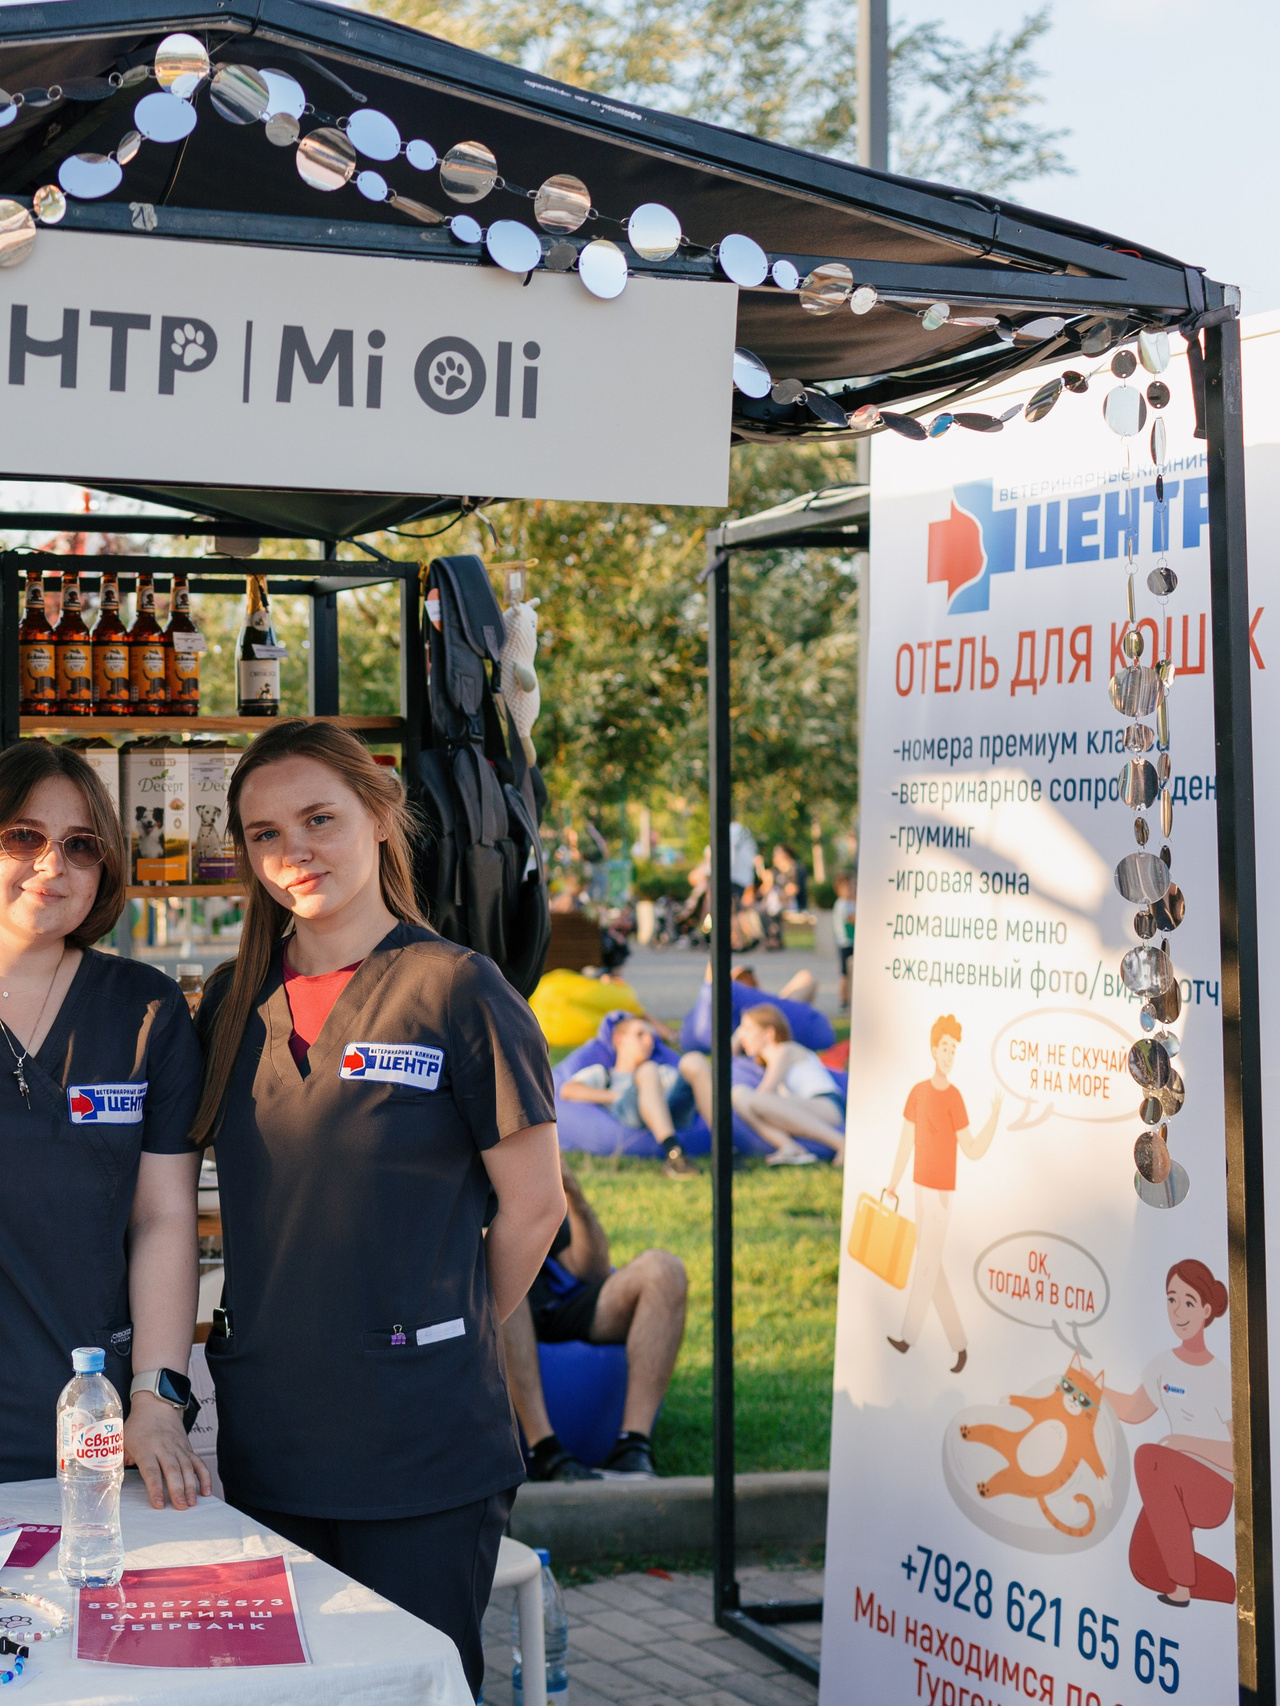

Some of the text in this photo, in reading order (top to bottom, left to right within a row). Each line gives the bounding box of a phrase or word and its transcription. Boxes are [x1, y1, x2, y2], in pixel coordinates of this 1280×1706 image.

[277, 326, 385, 408] Mi
[414, 337, 541, 419] Oli
[1025, 476, 1210, 570] ЦЕНТР
[895, 607, 1266, 698] ОТЕЛЬ ДЛЯ КОШК
[893, 727, 1171, 766] -номера премиум клаа
[891, 773, 1218, 810] -ветеринарное сопроден
[890, 825, 975, 855] -груминг
[888, 870, 1030, 900] -игровая зона
[886, 913, 1068, 945] -домашнее меню
[885, 955, 1022, 990] -ежедневный
[379, 1055, 440, 1078] ЦЕНТР
[1047, 1043, 1066, 1065] НЕ
[1029, 1069, 1111, 1099] Я НА МОРЕ
[107, 1095, 146, 1112] ЦЕНТ
[988, 1268, 1096, 1313] ТОГДА Я В СПА
[101, 1611, 273, 1620] ВАЛЕРИЯ Ш
[110, 1622, 265, 1631] СБЕРБАНК
[901, 1545, 1180, 1695] +7928 621 65 65
[854, 1586, 896, 1638] Мы
[904, 1616, 1055, 1706] находимся
